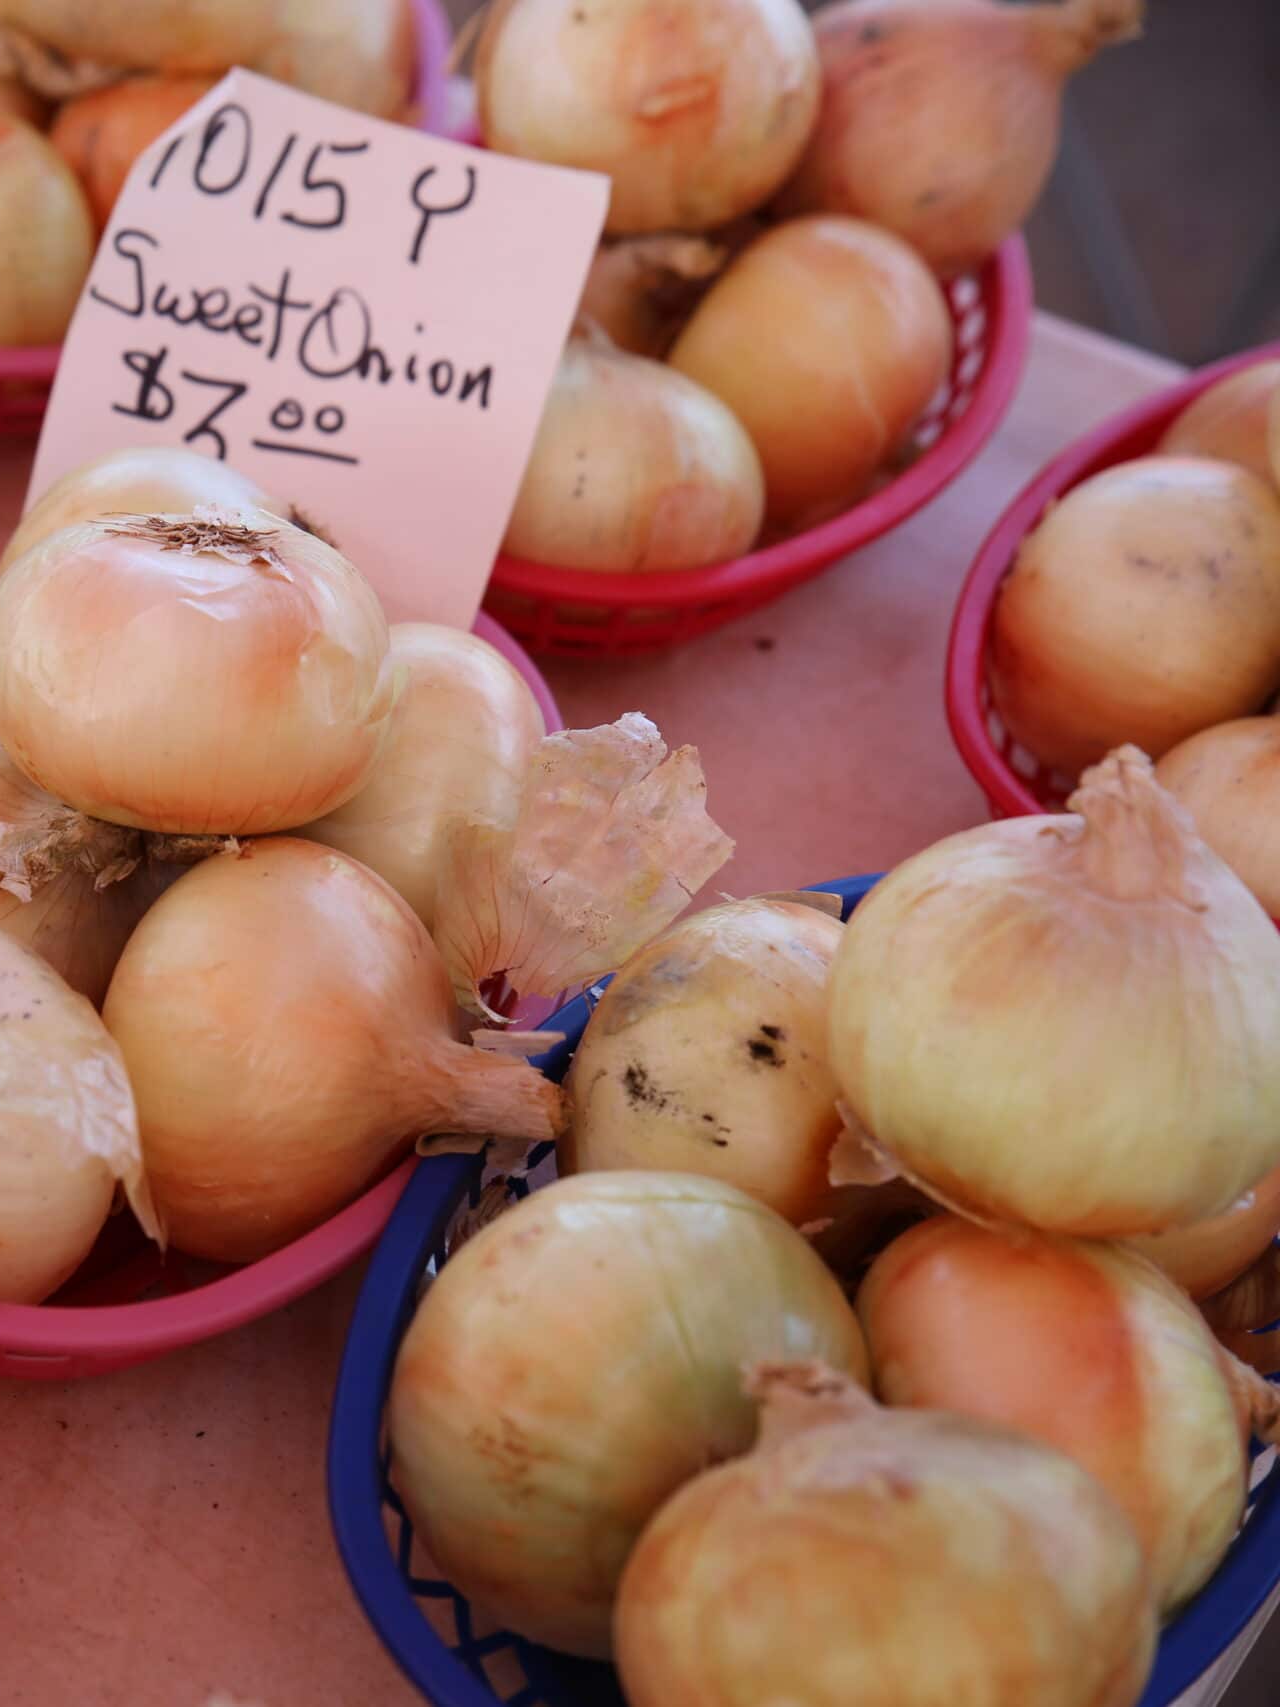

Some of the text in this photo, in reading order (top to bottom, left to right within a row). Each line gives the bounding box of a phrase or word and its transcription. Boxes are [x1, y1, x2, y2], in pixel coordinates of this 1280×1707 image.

[150, 103, 476, 264] 1015 Y
[91, 228, 494, 410] Sweet Onion
